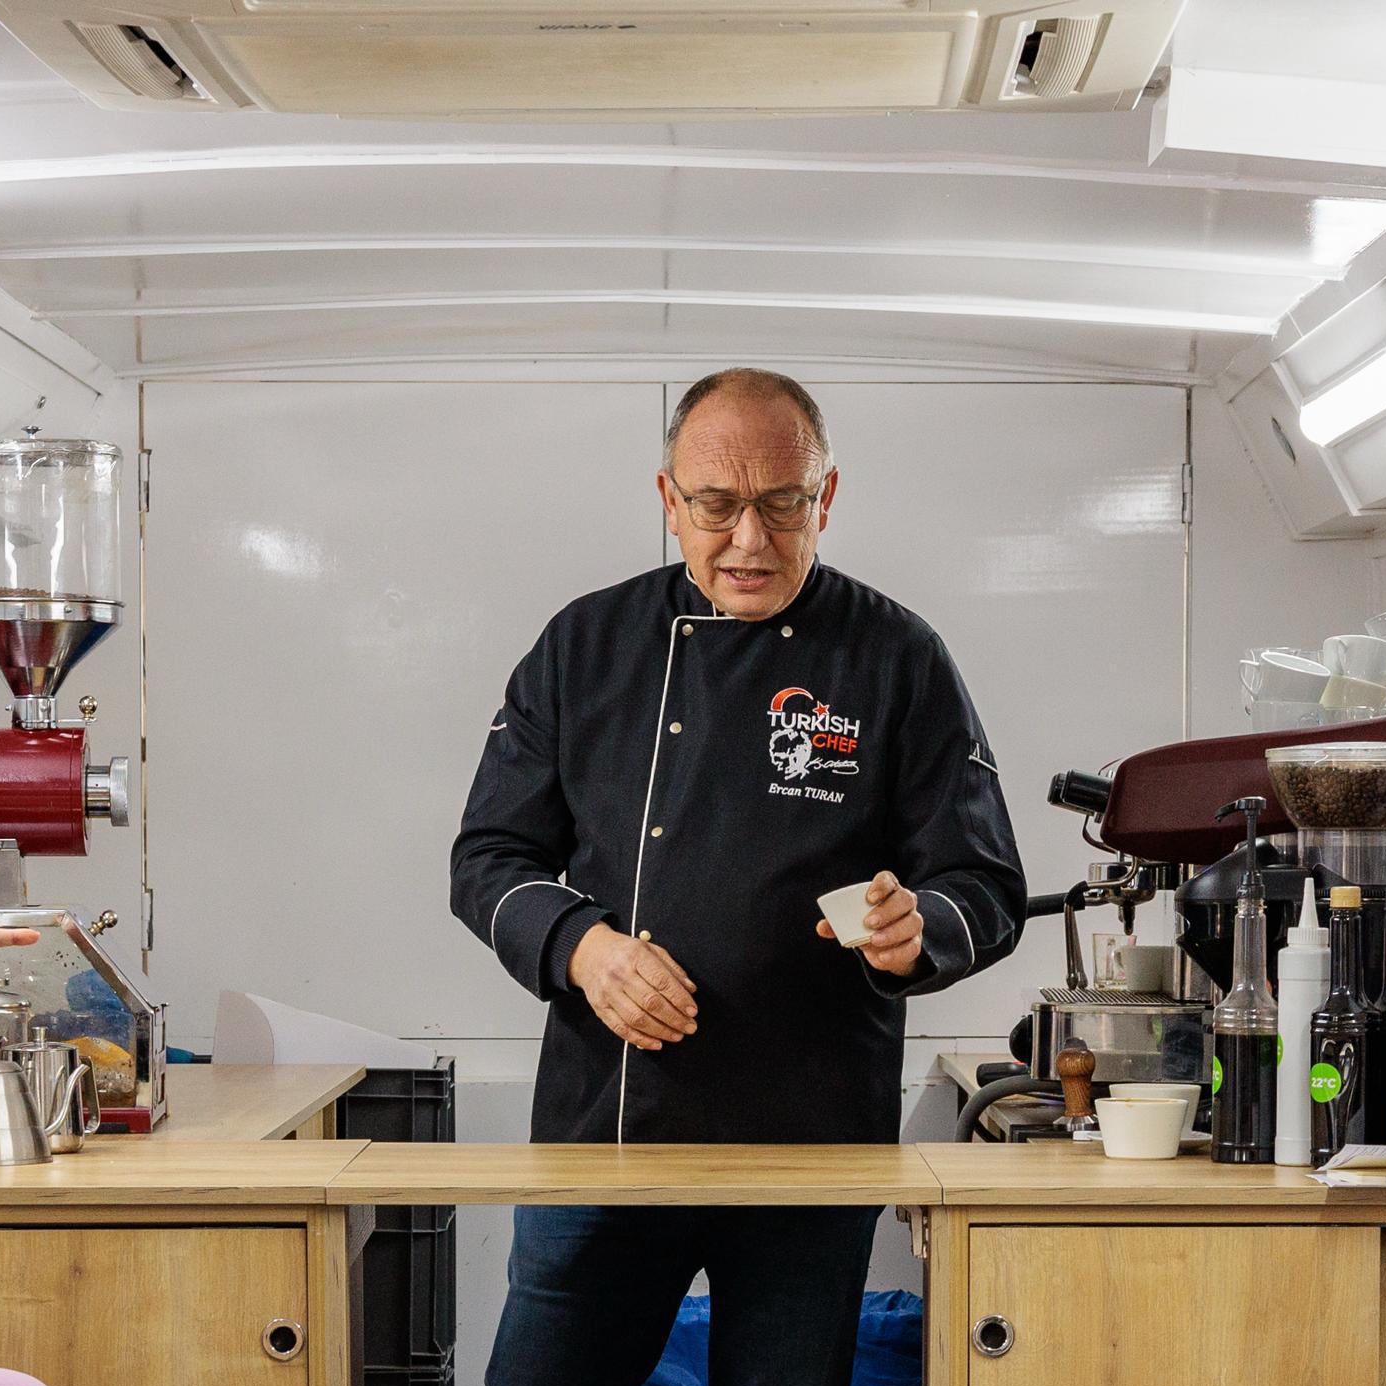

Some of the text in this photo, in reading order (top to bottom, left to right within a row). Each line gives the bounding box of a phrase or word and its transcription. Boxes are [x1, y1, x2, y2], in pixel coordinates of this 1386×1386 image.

[767, 711, 860, 738] TURKISH
[812, 733, 858, 753] CHEF
[768, 783, 845, 803] Ercan TURAN
[1311, 1077, 1336, 1088] 22°C
